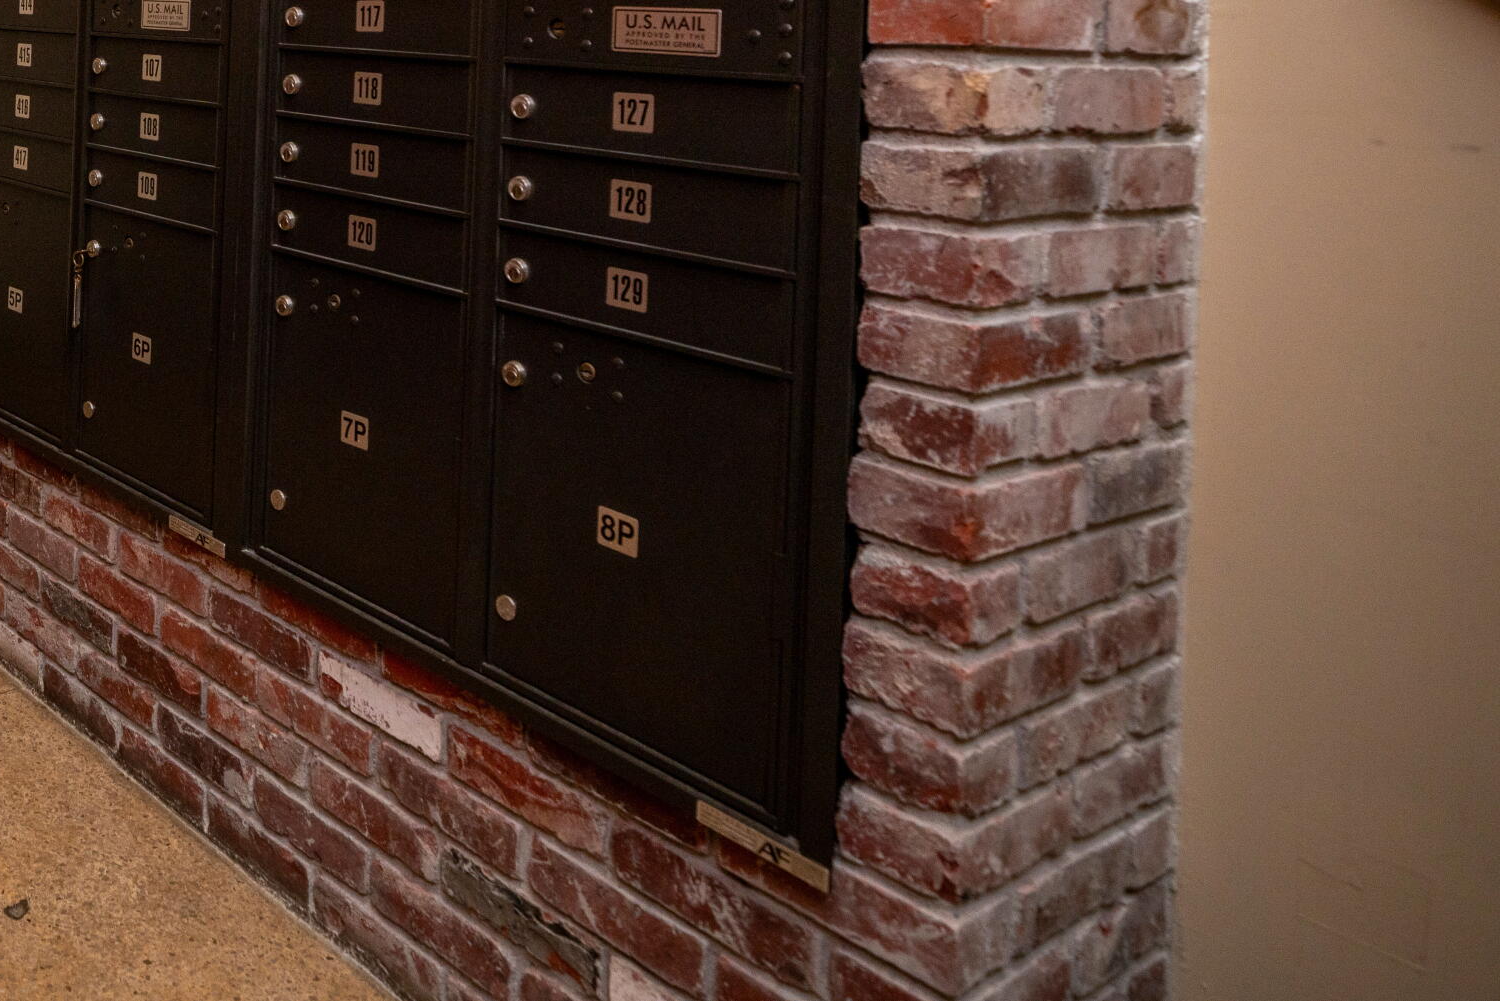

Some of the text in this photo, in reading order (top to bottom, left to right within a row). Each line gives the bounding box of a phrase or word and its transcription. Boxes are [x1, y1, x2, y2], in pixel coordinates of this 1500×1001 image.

[148, 4, 184, 14] U.S. MAIL
[360, 5, 381, 27] 117
[626, 14, 705, 31] U.S. MAIL
[19, 46, 30, 64] 415
[145, 58, 160, 78] 107
[357, 77, 378, 100] 118
[618, 98, 649, 126] 127
[143, 117, 158, 137] 108
[15, 148, 27, 166] 417
[354, 148, 375, 173] 119
[140, 176, 155, 196] 109
[616, 186, 647, 216] 128
[352, 220, 373, 246] 120
[9, 290, 22, 308] 5P
[612, 274, 643, 306] 129
[133, 338, 150, 358] 6P
[343, 416, 366, 442] 7P
[600, 514, 635, 546] 8P
[760, 842, 790, 863] AF
